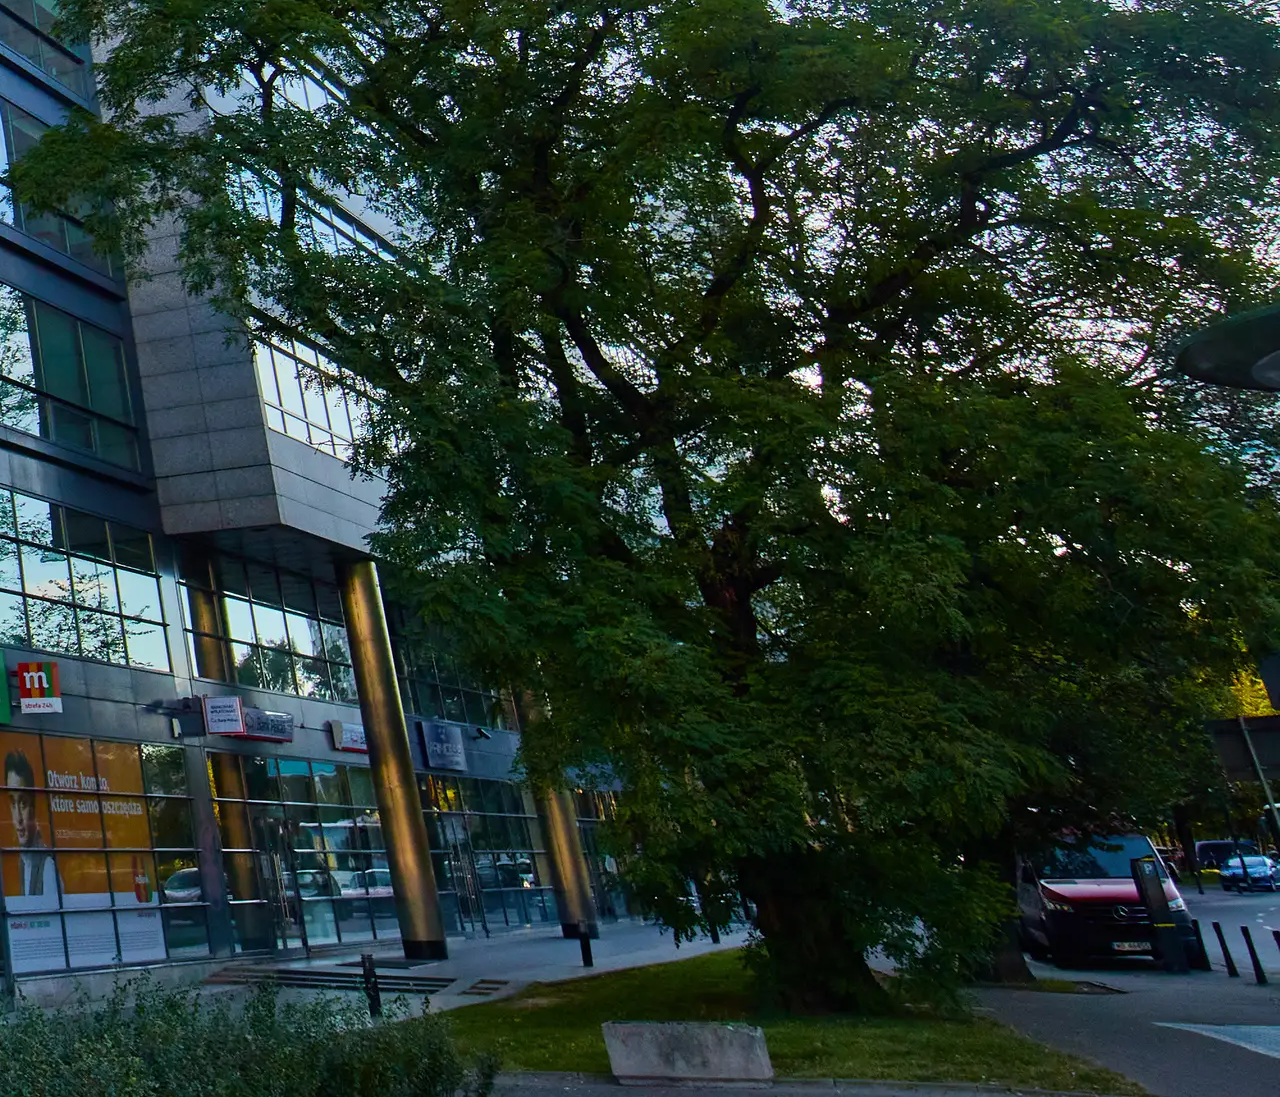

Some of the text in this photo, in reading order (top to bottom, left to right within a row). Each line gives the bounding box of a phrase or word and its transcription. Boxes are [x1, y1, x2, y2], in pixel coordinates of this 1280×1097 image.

[23, 671, 49, 689] m
[25, 702, 41, 710] strefa
[47, 769, 78, 789] Otwórz
[50, 794, 74, 813] które
[76, 799, 99, 813] samo
